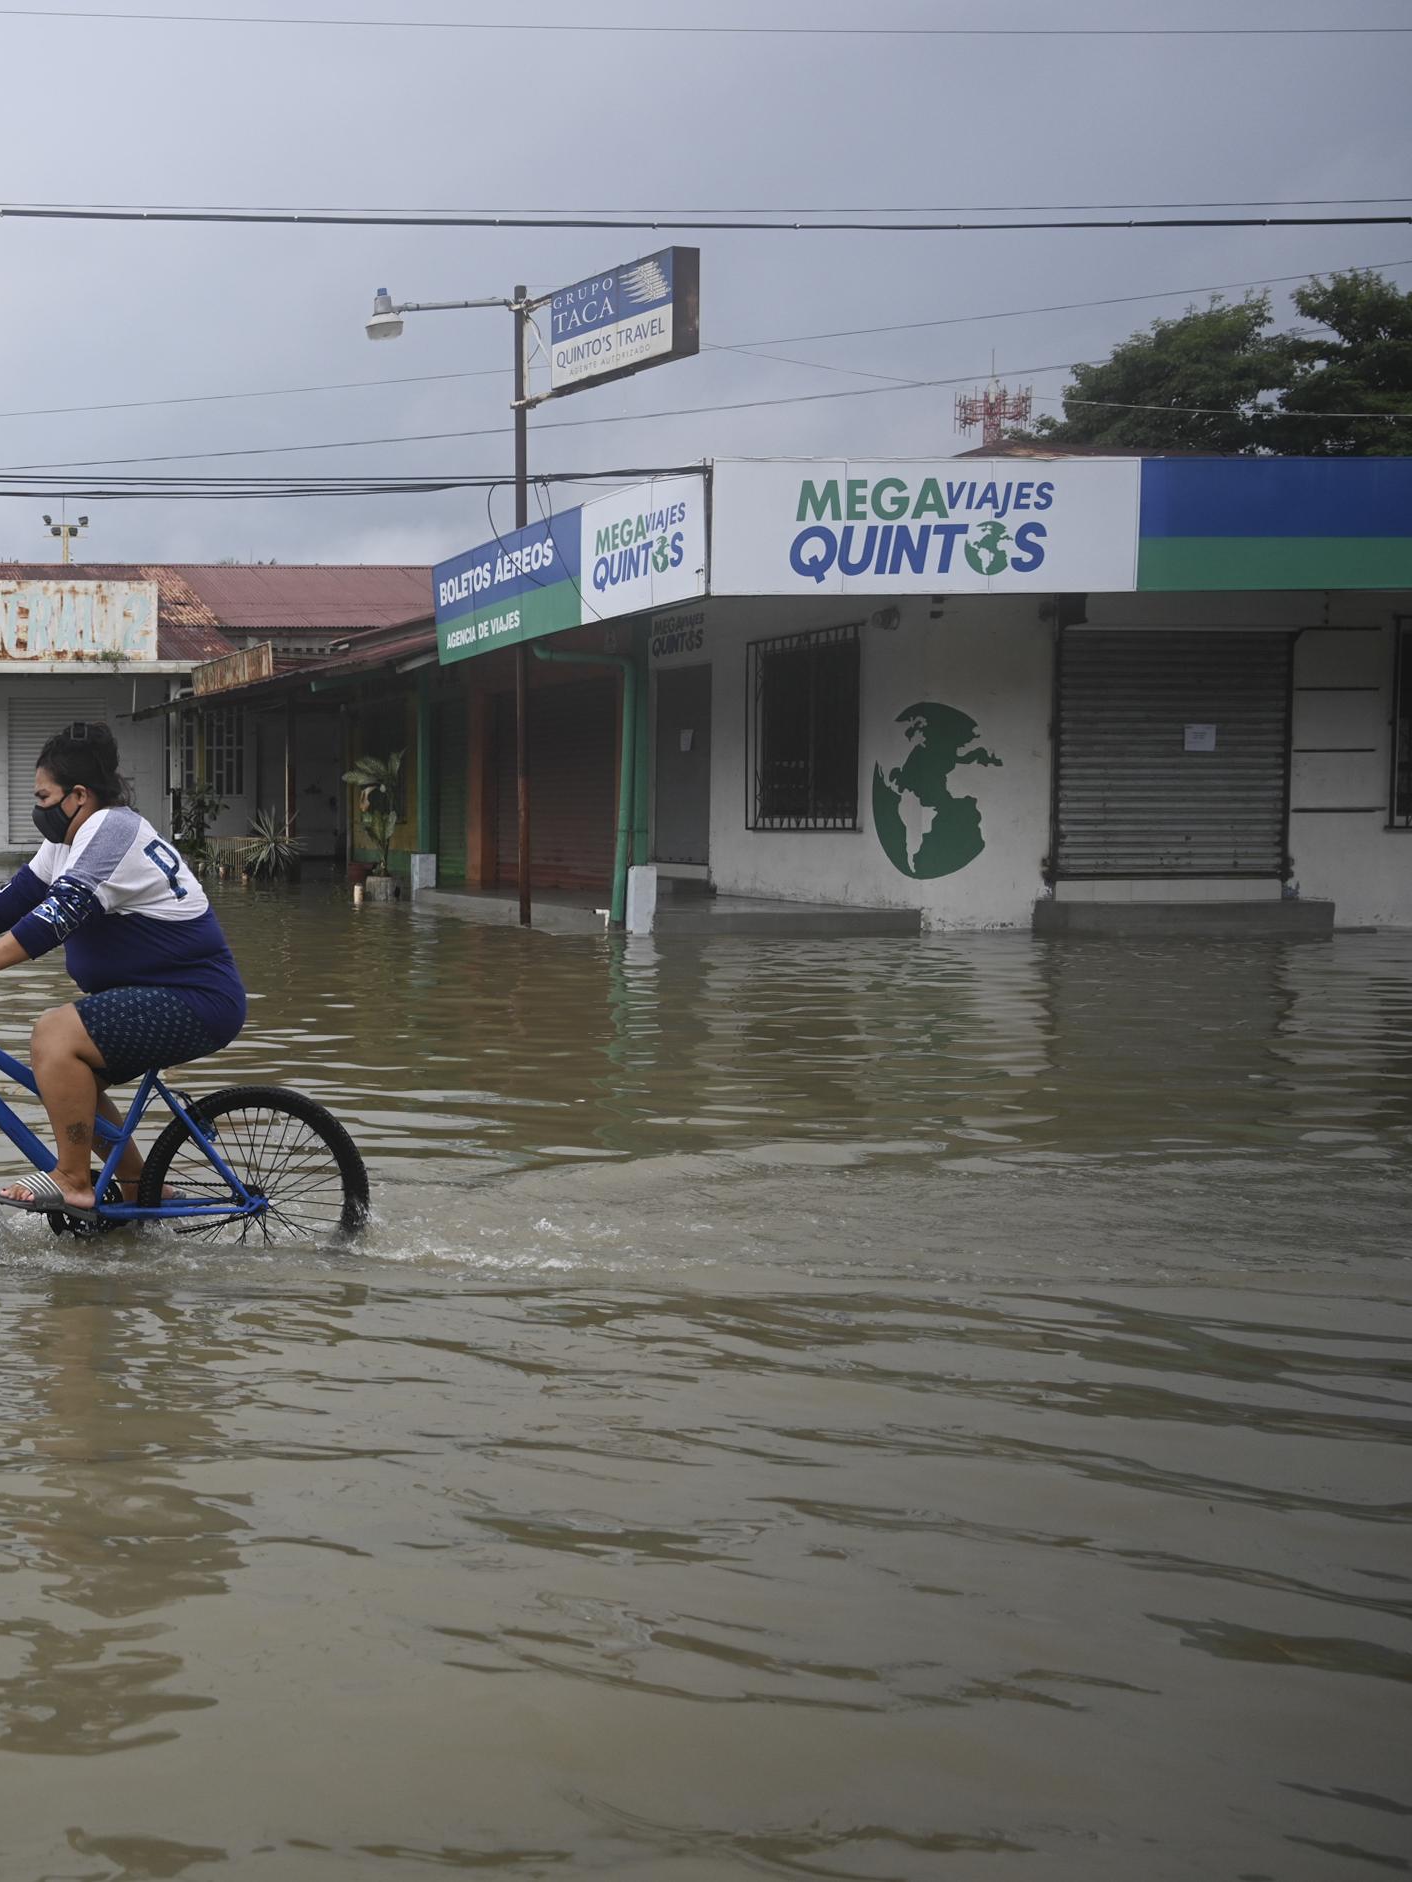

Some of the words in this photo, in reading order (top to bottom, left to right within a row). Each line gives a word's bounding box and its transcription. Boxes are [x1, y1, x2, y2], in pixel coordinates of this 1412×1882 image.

[553, 277, 613, 310] GRUPO
[553, 296, 615, 334] TACA
[556, 334, 613, 369] QUINTO'S
[616, 317, 665, 348] TRAVEL
[569, 361, 597, 376] AGENTE
[601, 343, 651, 366] AUTORIZADO
[439, 561, 492, 607] BOLETOS
[122, 591, 152, 650] 2
[446, 628, 477, 650] AGENCIA
[478, 623, 489, 638] DE
[490, 609, 520, 634] VIAJES
